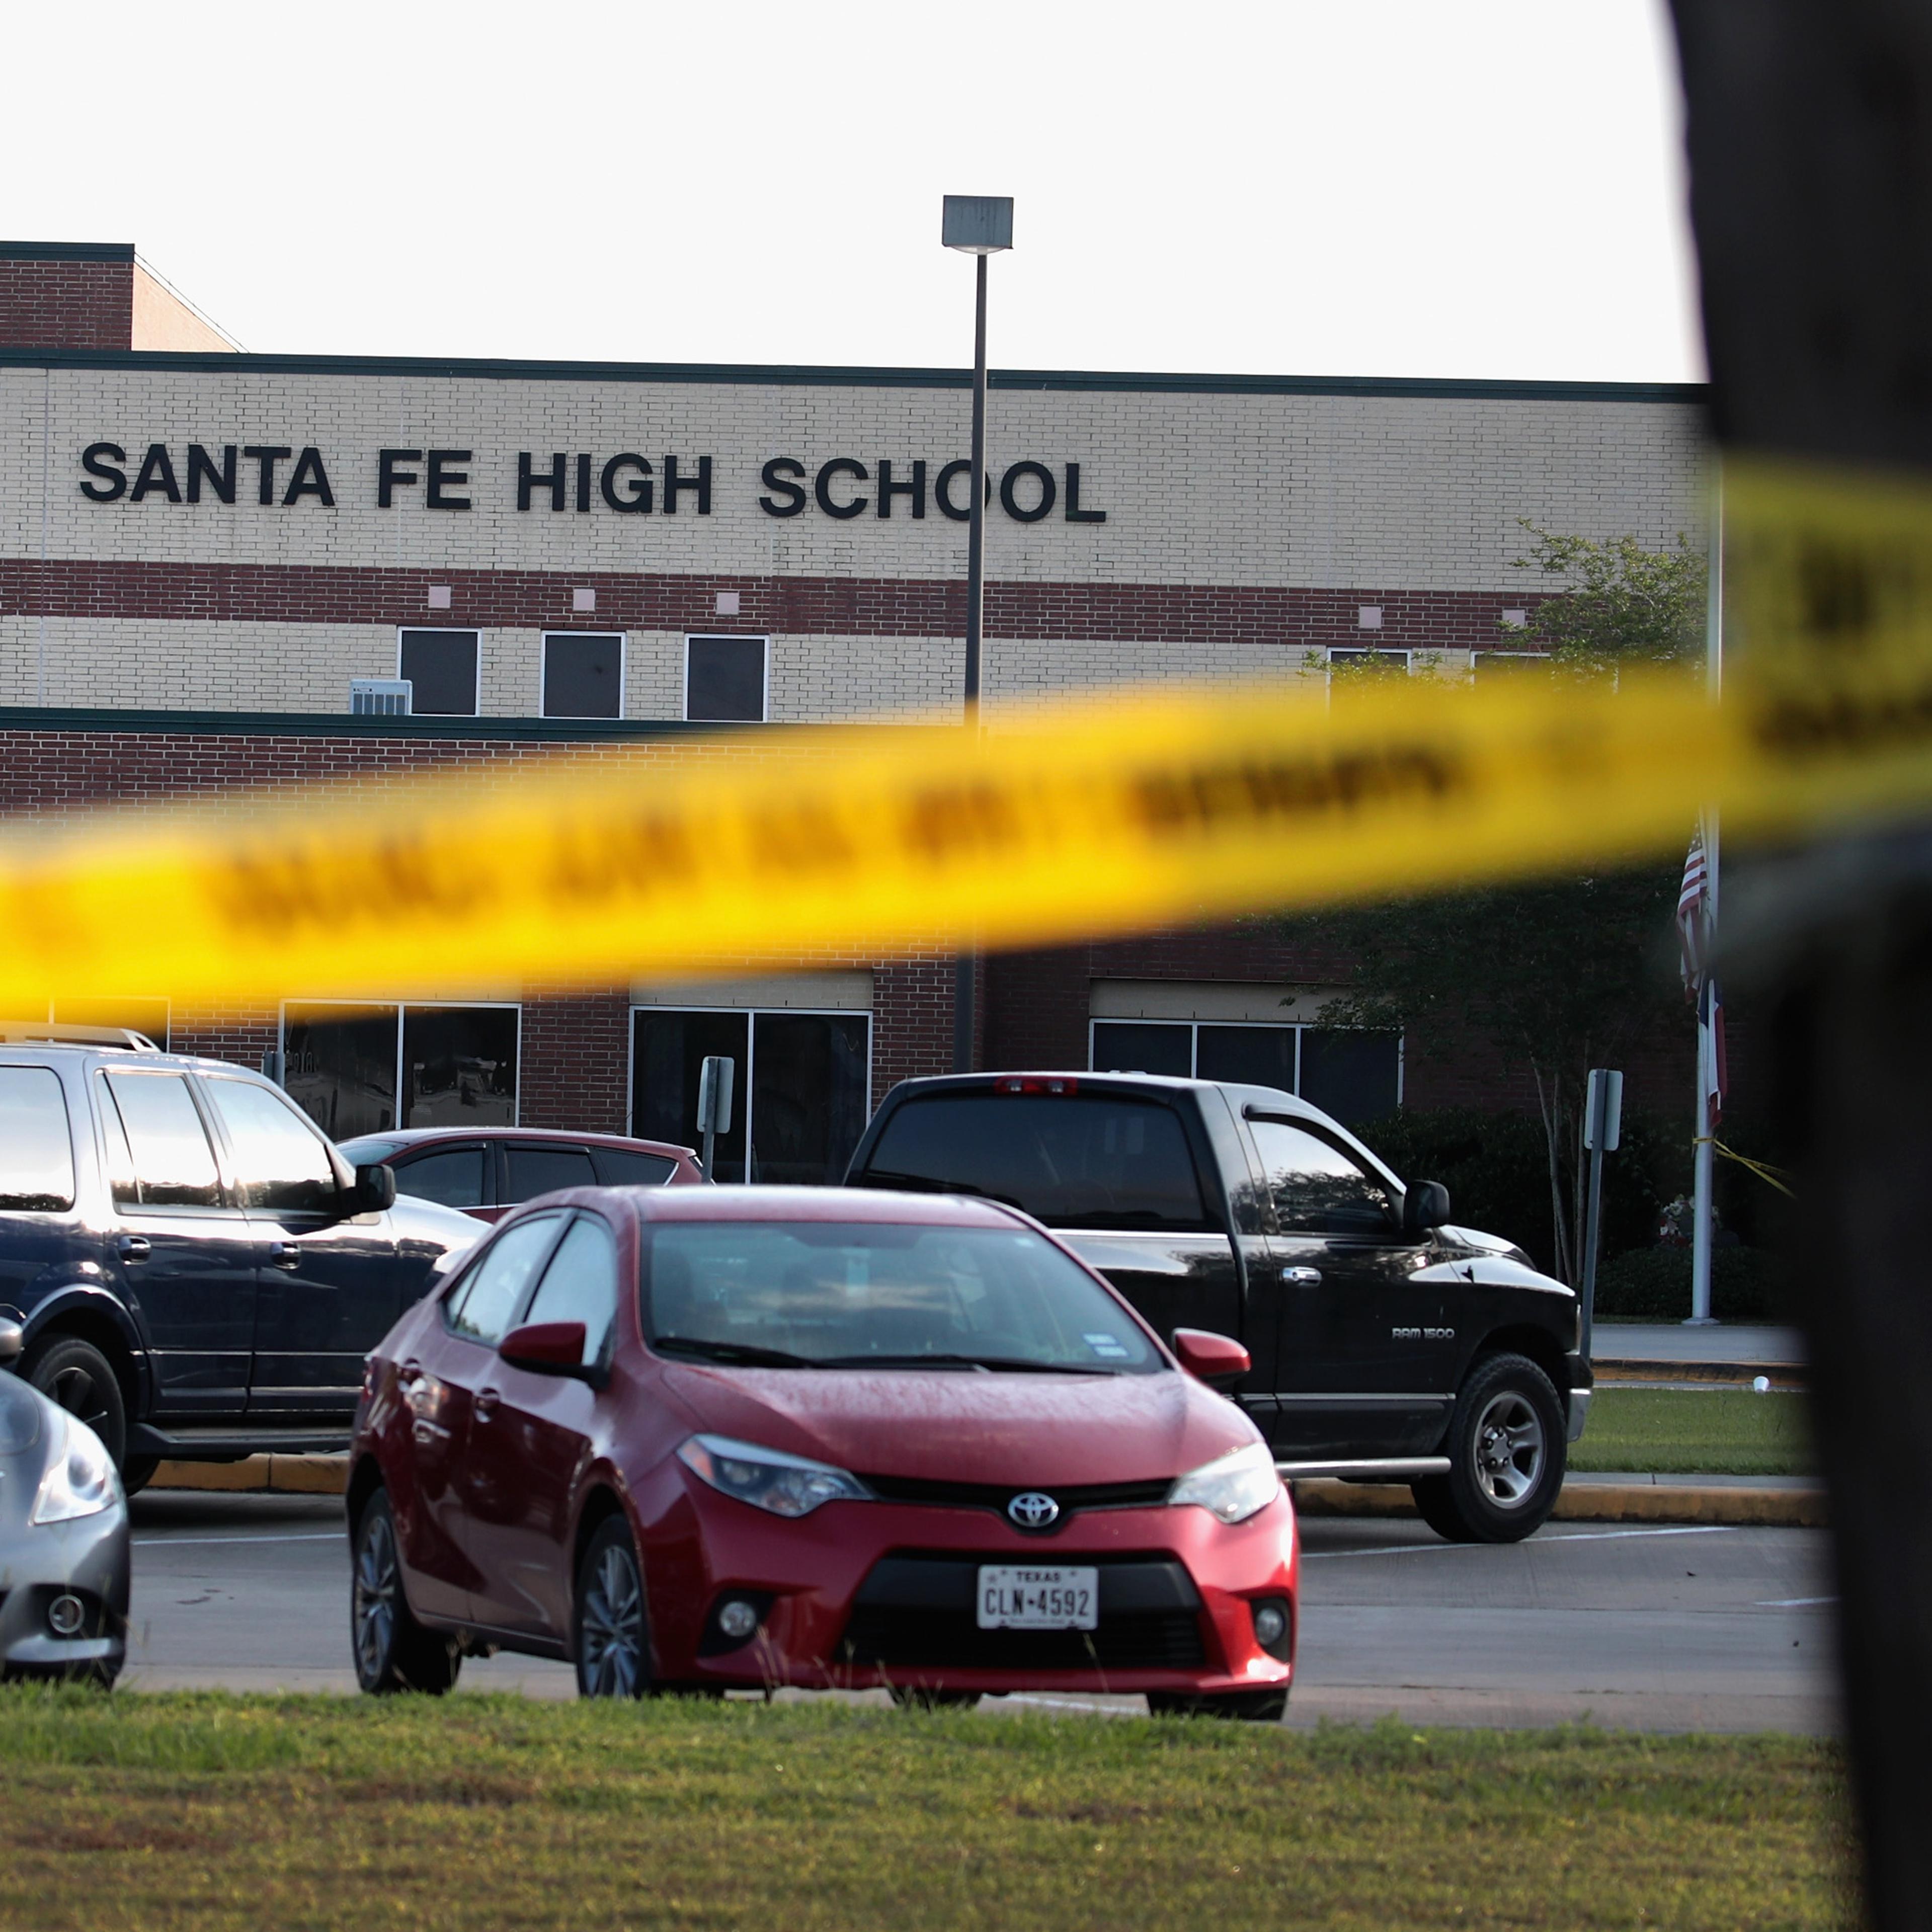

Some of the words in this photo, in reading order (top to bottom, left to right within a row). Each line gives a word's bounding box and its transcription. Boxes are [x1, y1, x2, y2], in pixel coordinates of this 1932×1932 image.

[79, 442, 336, 507] SANTA
[378, 449, 472, 511] FE
[517, 452, 712, 515] HIGH
[759, 457, 1106, 524] SCHOOL
[1392, 1327, 1421, 1339] RAM
[1423, 1327, 1455, 1339] 1500
[1016, 1570, 1061, 1583] TEXAS
